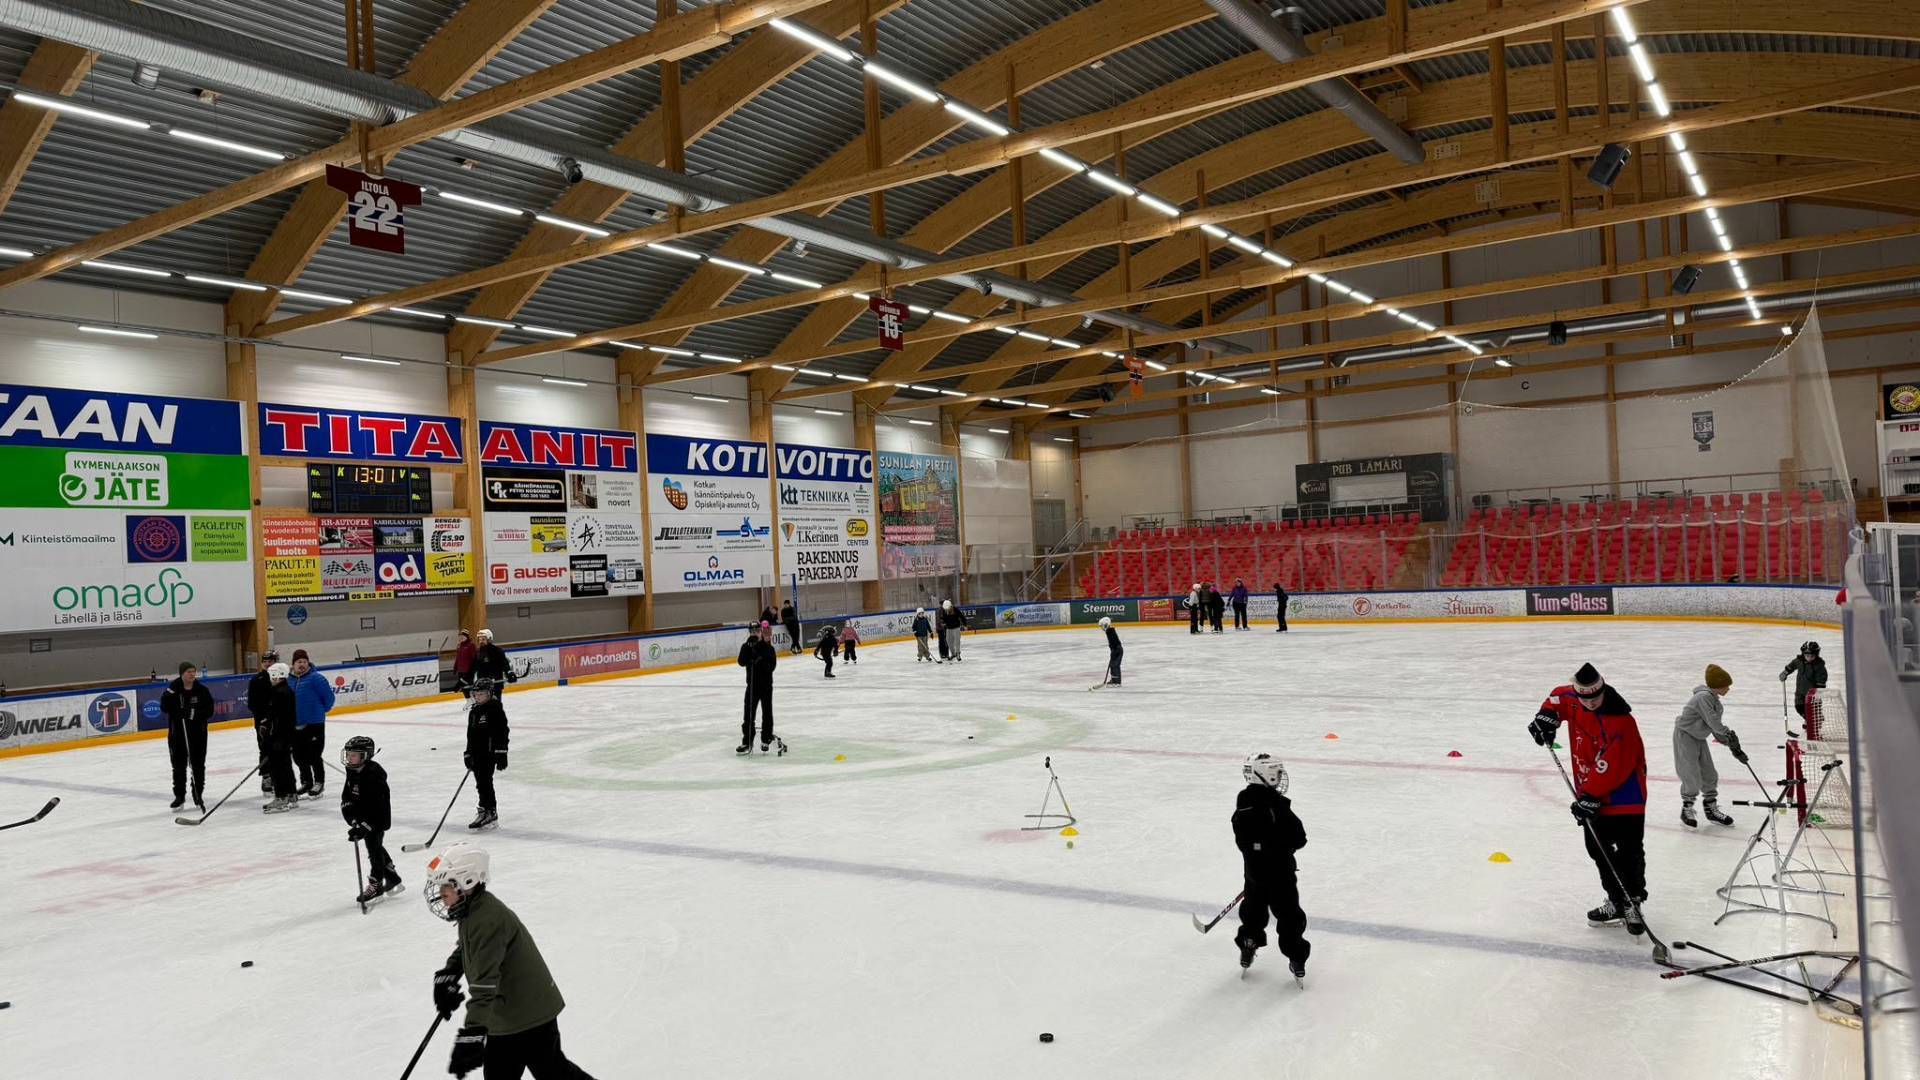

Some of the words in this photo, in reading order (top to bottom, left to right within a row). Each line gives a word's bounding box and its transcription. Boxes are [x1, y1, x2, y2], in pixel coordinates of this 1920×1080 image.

[361, 180, 390, 196] ILTOLA
[354, 191, 398, 235] 22
[265, 408, 462, 459] TITA
[480, 427, 636, 469] ANIT
[687, 442, 767, 474] KOTI
[879, 456, 922, 471] SUNILAN
[73, 460, 161, 472] KYMENLAAKSON
[337, 466, 345, 477] K
[1332, 464, 1353, 476] PUB
[355, 467, 395, 483] 13:01
[399, 469, 406, 479] V
[93, 472, 161, 501] JÄTE
[693, 480, 716, 489] Kotkan
[746, 491, 755, 501] Oy
[800, 489, 850, 503] TEKNIIKKA
[607, 499, 631, 507] novart
[695, 500, 750, 510] Opiskelija-asunnot
[751, 501, 760, 511] Oy
[193, 521, 245, 531] EAGLEFUN
[22, 534, 116, 544] Kiinteistömaailma
[846, 539, 869, 547] CENTER
[276, 547, 307, 555] huolto
[796, 550, 859, 565] RAKENNUS
[265, 558, 316, 570] PAKUT.FI
[378, 554, 422, 583] ad
[432, 559, 465, 571] RAKETTI
[439, 566, 465, 578] TUKKU
[514, 566, 568, 579] auser
[683, 569, 744, 581] OLMAR
[798, 566, 842, 581] PAKERA
[844, 565, 859, 579] OY
[533, 585, 550, 593] work
[1570, 592, 1608, 611] Glass
[1083, 603, 1126, 613] Stemma
[1452, 602, 1495, 615] Huuma
[54, 613, 98, 625] Lähellä
[99, 612, 111, 624] ja
[113, 611, 143, 622] läsnä
[580, 650, 637, 667] McDonald's
